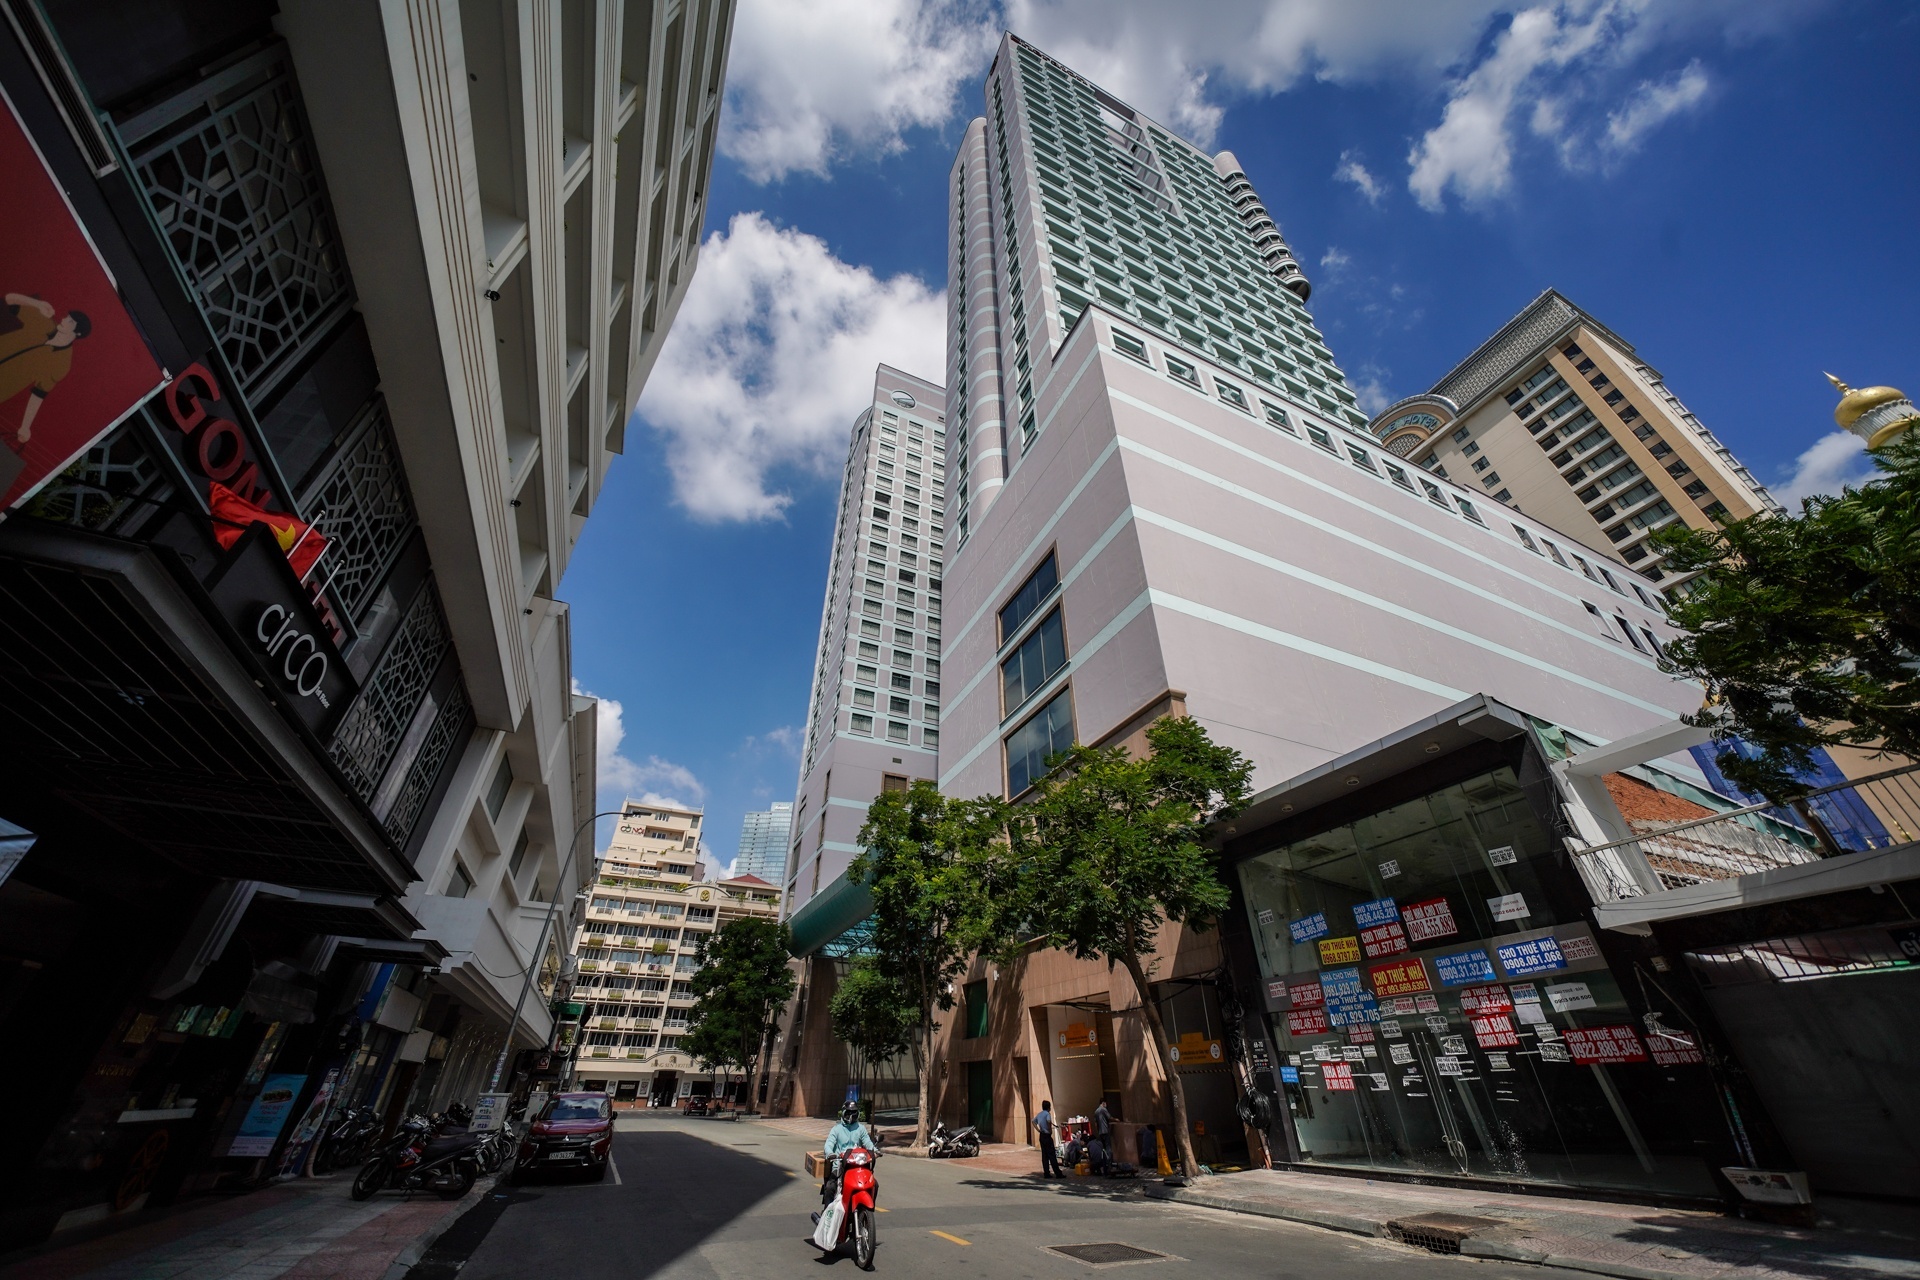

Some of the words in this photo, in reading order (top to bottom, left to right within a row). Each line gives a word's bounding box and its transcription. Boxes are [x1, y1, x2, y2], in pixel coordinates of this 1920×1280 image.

[1353, 906, 1366, 915] CHO
[1365, 900, 1382, 911] THUÊ
[1381, 897, 1395, 908] NHÀ
[1360, 931, 1374, 944] CHO
[1374, 925, 1390, 940] THUÊ
[1389, 922, 1404, 937] NHÀ
[1320, 943, 1330, 952] CHO
[1331, 939, 1345, 950] THUÊ
[1345, 938, 1358, 948] NHÀ
[1499, 949, 1516, 960] CHO
[1516, 941, 1539, 957] THUÊ
[1538, 937, 1558, 951] NHÀ
[1436, 958, 1451, 967] CHO
[1451, 953, 1470, 965] THUÊ
[1470, 951, 1487, 962] NHÀ
[1503, 950, 1563, 970] 0908.061.068
[1321, 971, 1332, 981] NHÀ
[1332, 972, 1344, 980] CHO
[1373, 971, 1387, 986] CHO
[1387, 964, 1405, 984] THUÊ
[1405, 961, 1425, 981] NHÀ
[1327, 998, 1340, 1006] CHO
[1340, 994, 1358, 1004] THUÊ
[1359, 992, 1373, 1001] NHÀ
[1472, 986, 1490, 996] THUÊ
[1490, 985, 1505, 994] NHÀ
[1287, 1011, 1298, 1019] CHO
[1298, 1008, 1312, 1018] THUÊ
[1311, 1007, 1323, 1016] NHÀ
[1331, 1009, 1381, 1025] 0981.929.705
[1471, 1015, 1491, 1035] NHÀ
[1490, 1014, 1512, 1032] BÁN
[1565, 1031, 1586, 1043] CHO
[1585, 1027, 1610, 1041] THUÊ
[1609, 1025, 1635, 1039] NHÀ
[1569, 1039, 1643, 1059] 0922.889.345
[1322, 1063, 1338, 1079] NHÀ
[1336, 1062, 1351, 1078] BÁN
